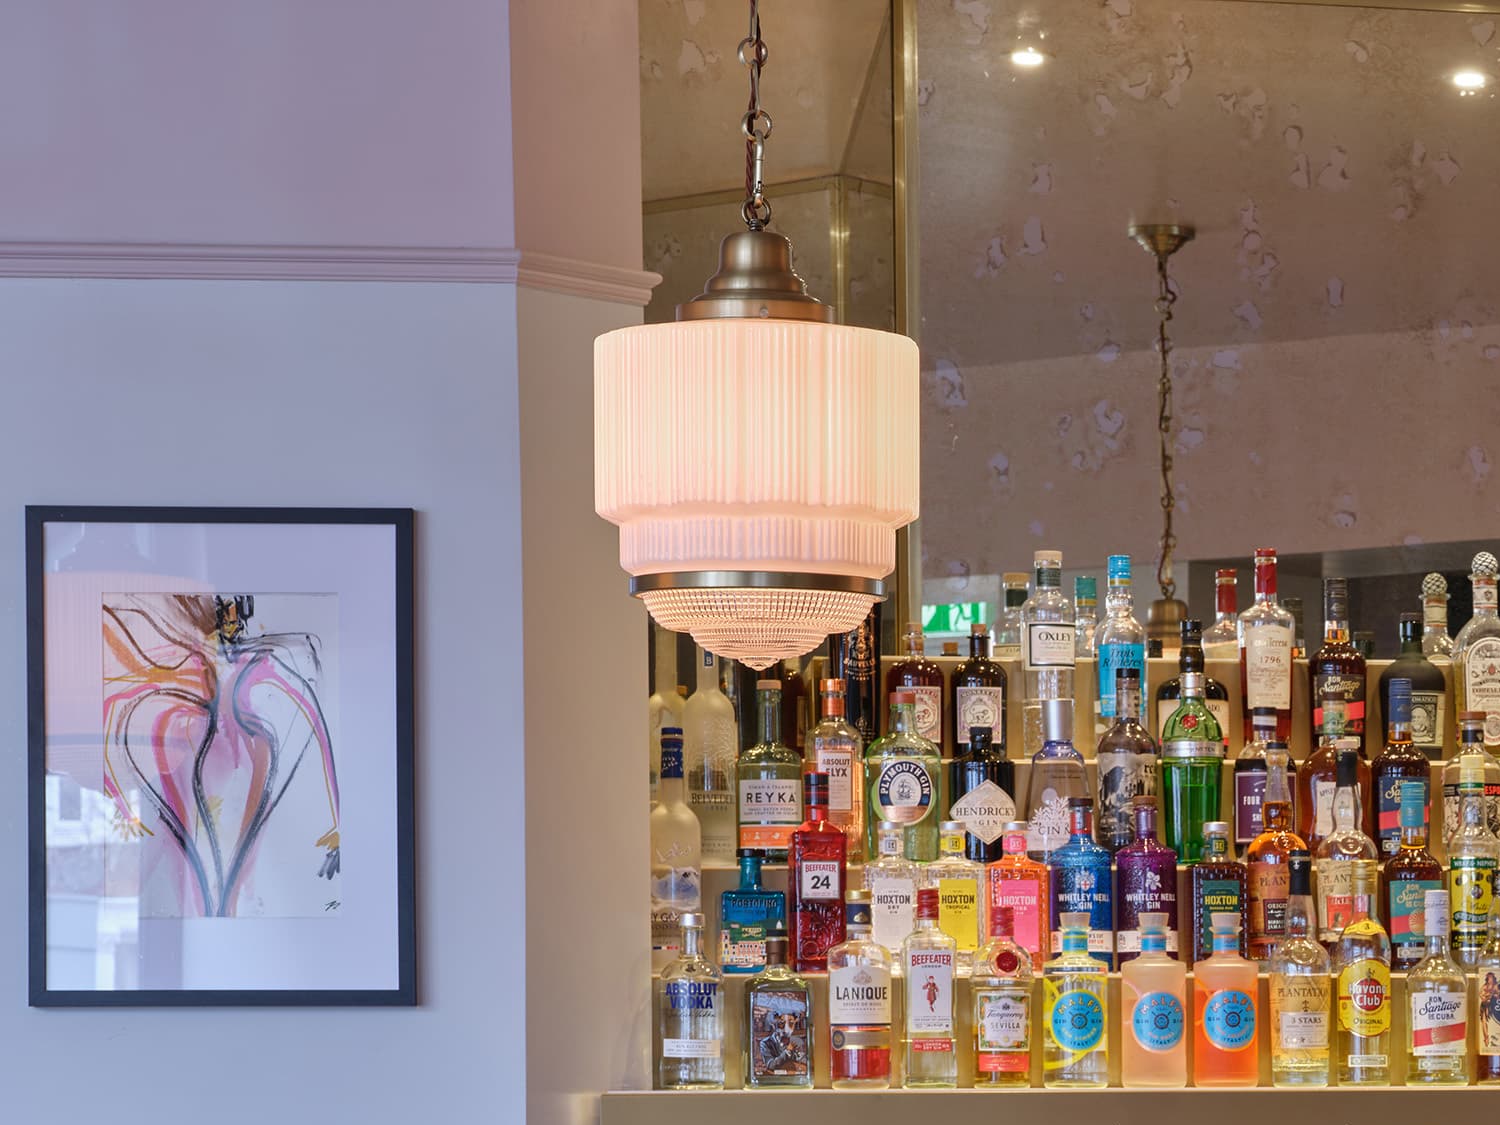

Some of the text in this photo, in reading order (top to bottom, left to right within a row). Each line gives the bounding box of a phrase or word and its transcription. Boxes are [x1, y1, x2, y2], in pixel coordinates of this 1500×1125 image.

[1039, 632, 1071, 642] OXLEY
[822, 758, 850, 767] ABSOLUT
[880, 763, 931, 796] PLYMOUTH GIN
[747, 793, 796, 804] REYKA
[1243, 796, 1260, 805] FOUR
[979, 818, 998, 826] GIN
[805, 864, 837, 873] BEEFEATER
[811, 875, 831, 890] 24
[878, 895, 911, 905] HOXTON
[942, 894, 975, 904] HOXTON
[1003, 895, 1036, 905] HOXTON
[1058, 893, 1092, 903] WHITLEY
[1126, 893, 1159, 903] WHITLEY
[1205, 895, 1239, 905] HOXTON
[1146, 901, 1161, 910] GIN
[911, 954, 951, 966] BEEFEATER
[665, 983, 718, 996] ABSOLUT
[836, 987, 888, 1001] LANIQUE
[1349, 984, 1385, 995] Havana
[670, 996, 714, 1009] VODKA
[1355, 994, 1381, 1007] Club
[1428, 996, 1442, 1004] RON
[1057, 997, 1101, 1015] MALFY
[1418, 1000, 1462, 1016] Santiago
[986, 1010, 1024, 1020] Tanqueray
[1436, 1012, 1455, 1021] CUBA
[990, 1022, 1020, 1030] SEVILLA
